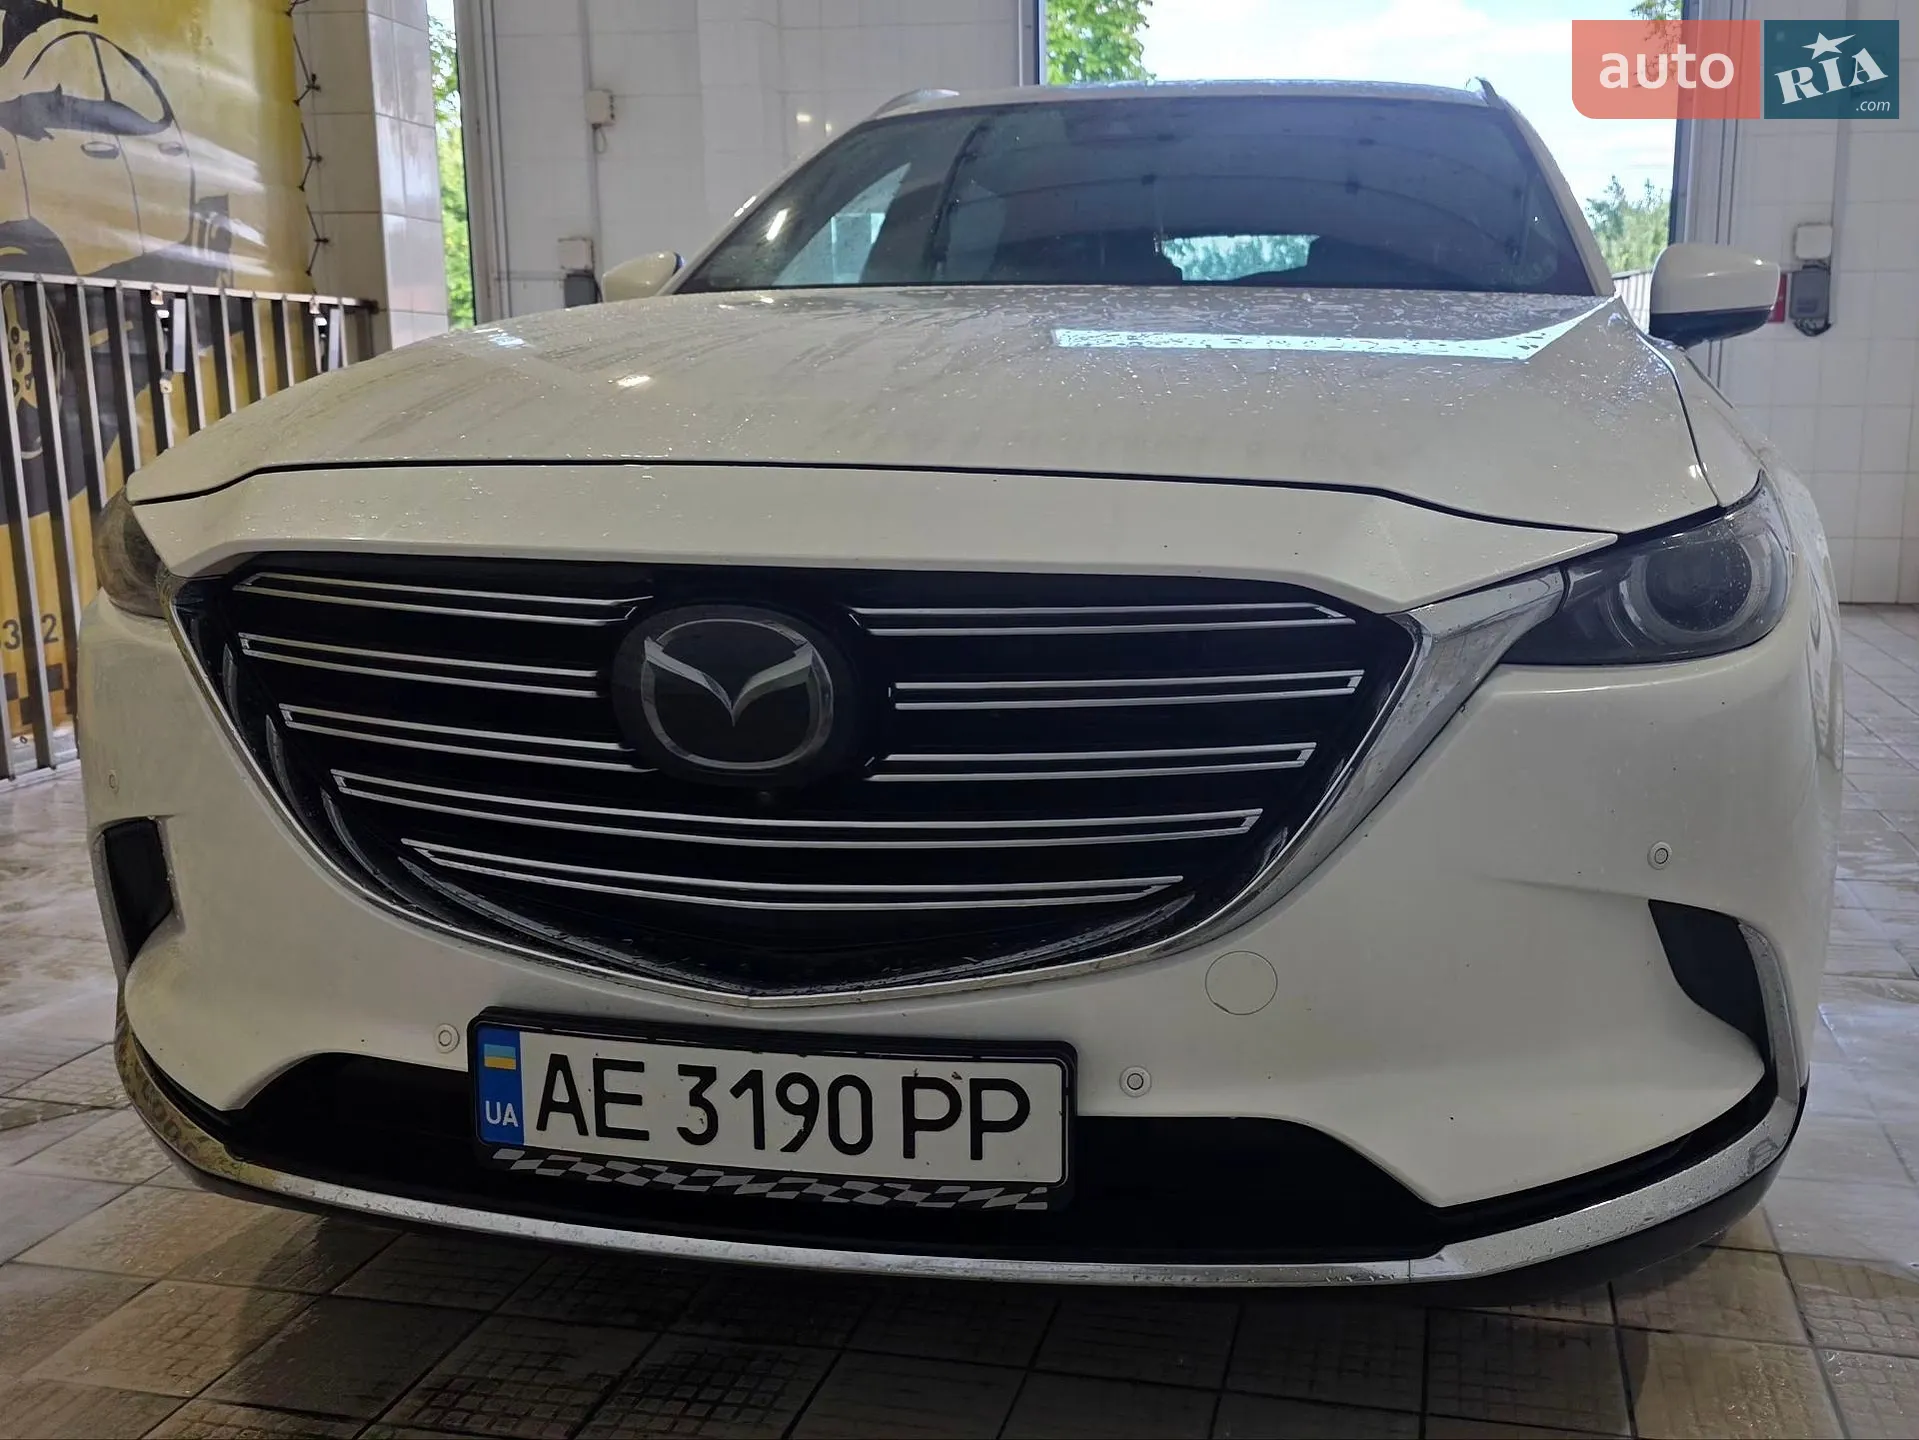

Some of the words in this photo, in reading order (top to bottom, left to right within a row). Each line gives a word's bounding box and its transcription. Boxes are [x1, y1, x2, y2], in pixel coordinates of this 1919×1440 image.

[484, 1099, 519, 1128] UA
[535, 1053, 650, 1141] AE
[676, 1063, 874, 1156] 3190
[901, 1075, 1031, 1161] PP
